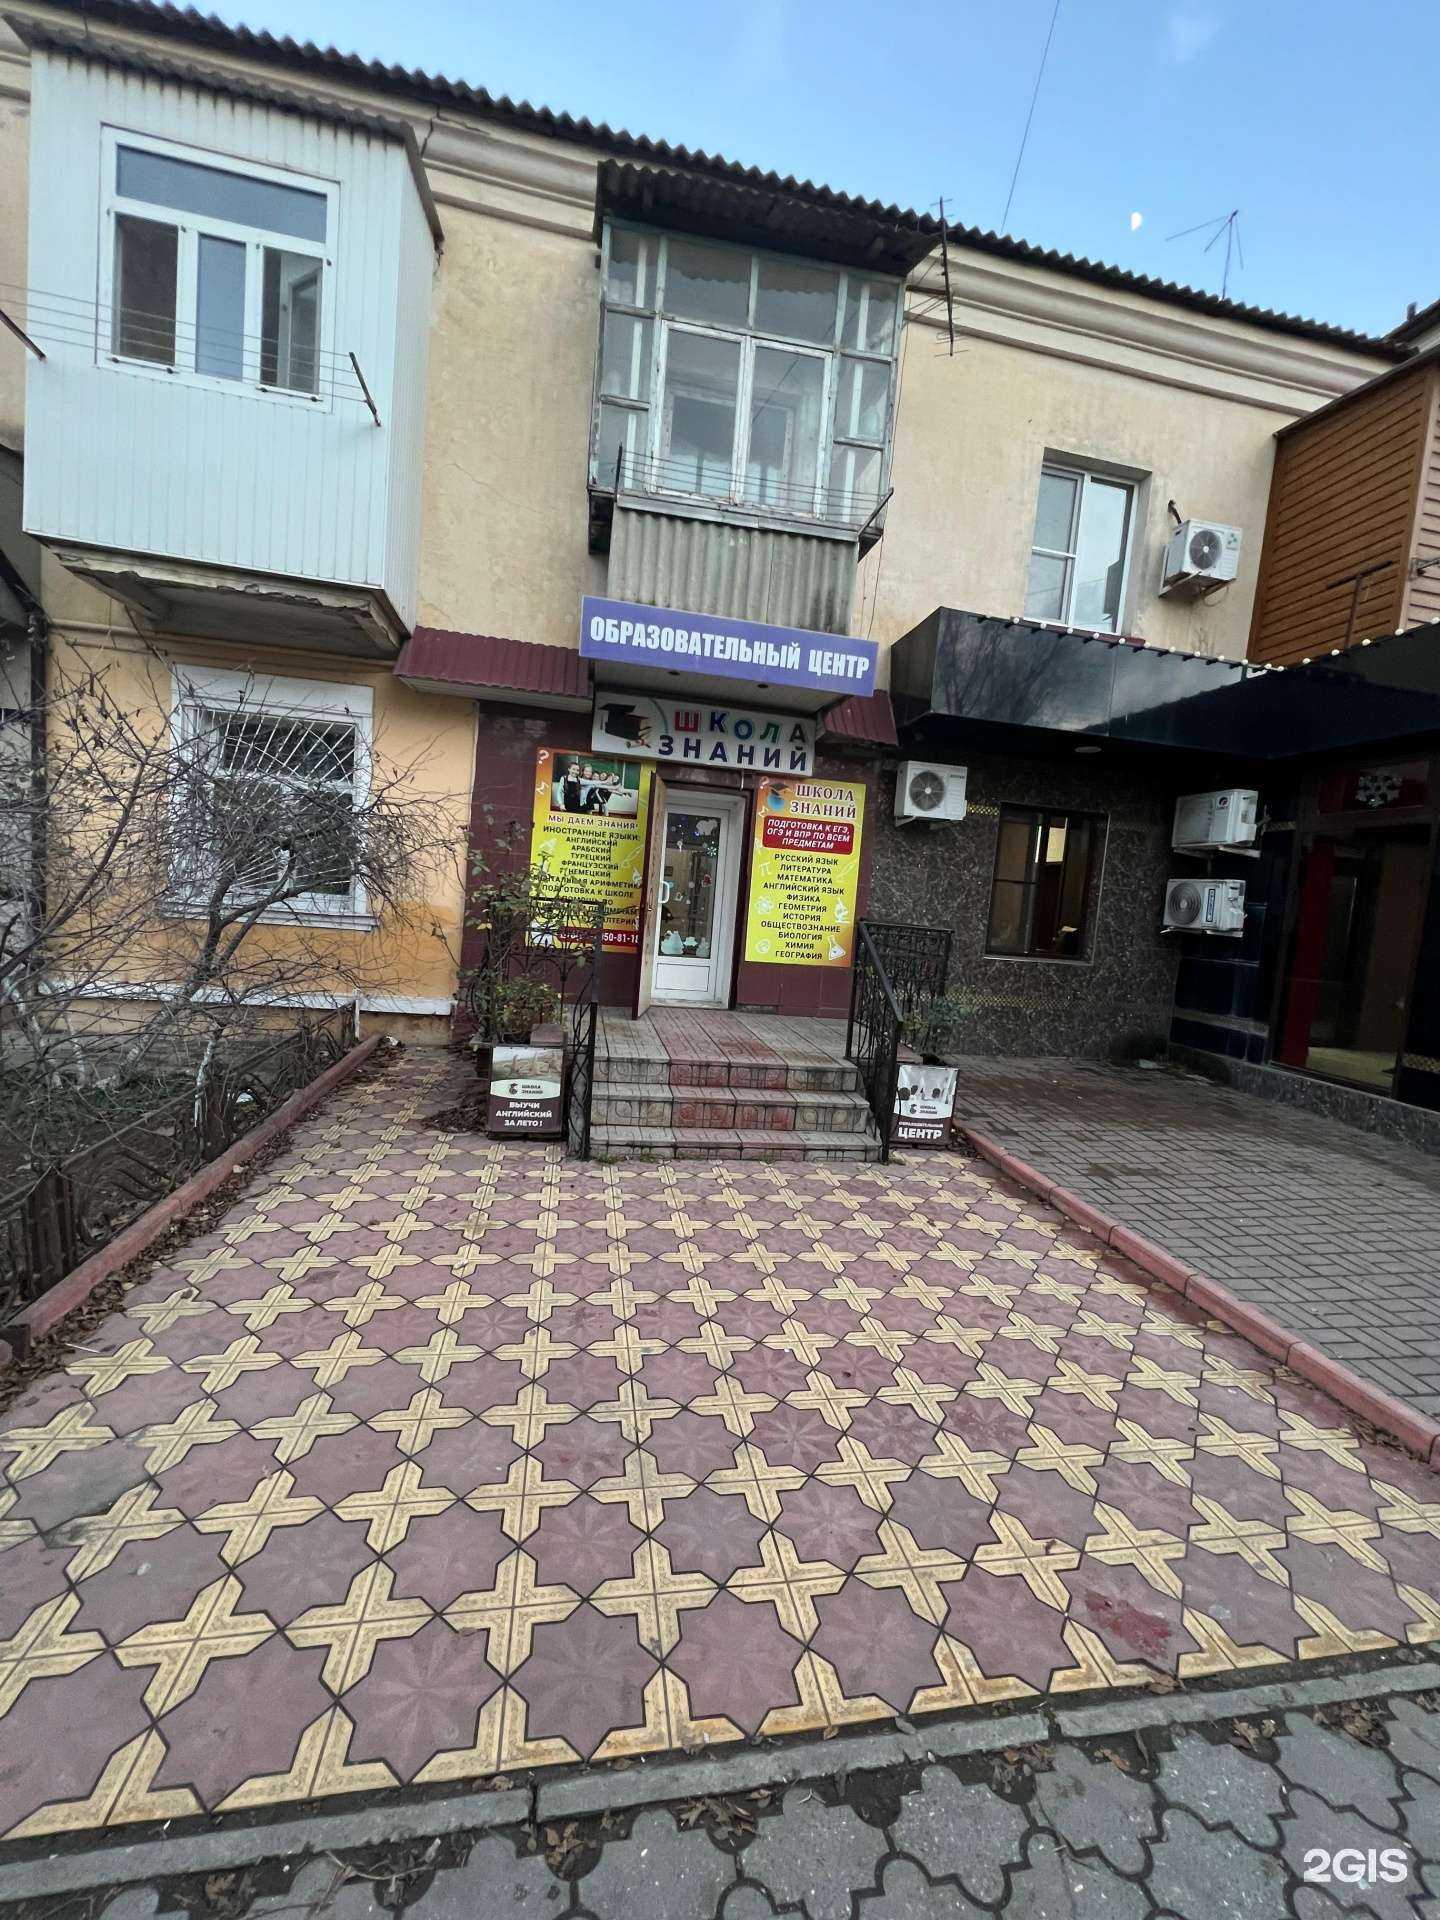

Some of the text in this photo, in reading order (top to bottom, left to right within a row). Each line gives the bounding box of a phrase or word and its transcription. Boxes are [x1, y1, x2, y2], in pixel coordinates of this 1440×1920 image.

[590, 616, 870, 679] ОБРАЗОВАТЕЛЬНЫЙ ЦЕНТР
[674, 708, 806, 744] ШКОЛА
[658, 734, 807, 772] ЗНАНИЙ
[796, 784, 854, 800] ШКОЛА
[790, 801, 856, 818] ЗНАНИЙ
[768, 819, 823, 830] ПОДГОТОВКА
[833, 825, 850, 834] ЕГЭ,
[544, 826, 606, 838] ИНОСТРАННЫЕ
[767, 828, 783, 836] ОГЭ
[794, 830, 811, 838] ВПР
[813, 832, 825, 840] ПО
[827, 834, 850, 842] ВСЕМ
[566, 836, 618, 846] АНГЛИЙСКИЙ
[782, 838, 834, 849] ПРЕДМЕТАМ
[572, 845, 611, 853] АРАБСКИЙ
[570, 853, 611, 862] ТУРЕЦКИЙ
[774, 853, 838, 866] РУССКИЙ ЯЗЫК
[562, 860, 618, 870] ФРАНЦУЗСКИЙ
[780, 864, 832, 874] ЛИТЕРАТУРА
[568, 868, 610, 878] НЕМЕЦКИЙ
[777, 874, 832, 884] МАТЕМАТИКА
[542, 884, 595, 895] ПОДГОТОВКА
[764, 882, 844, 895] АНГЛИЙСКИЙ ЯЗЫК
[786, 894, 820, 903] ФИЗИКА
[778, 902, 827, 912] ГЕОМЕТРИЯ
[783, 912, 820, 922] ИСТОРИЯ
[761, 920, 841, 932] ОБЩЕСТВОЗНАНИЕ
[778, 932, 822, 941] БИОЛОГИЯ
[785, 942, 814, 950] ХИМИЯ
[776, 950, 822, 960] ГЕОГРАФИЯ
[496, 1110, 552, 1118] АНГЛИЙСКИЙ
[898, 1127, 942, 1140] ЦЕНТР
